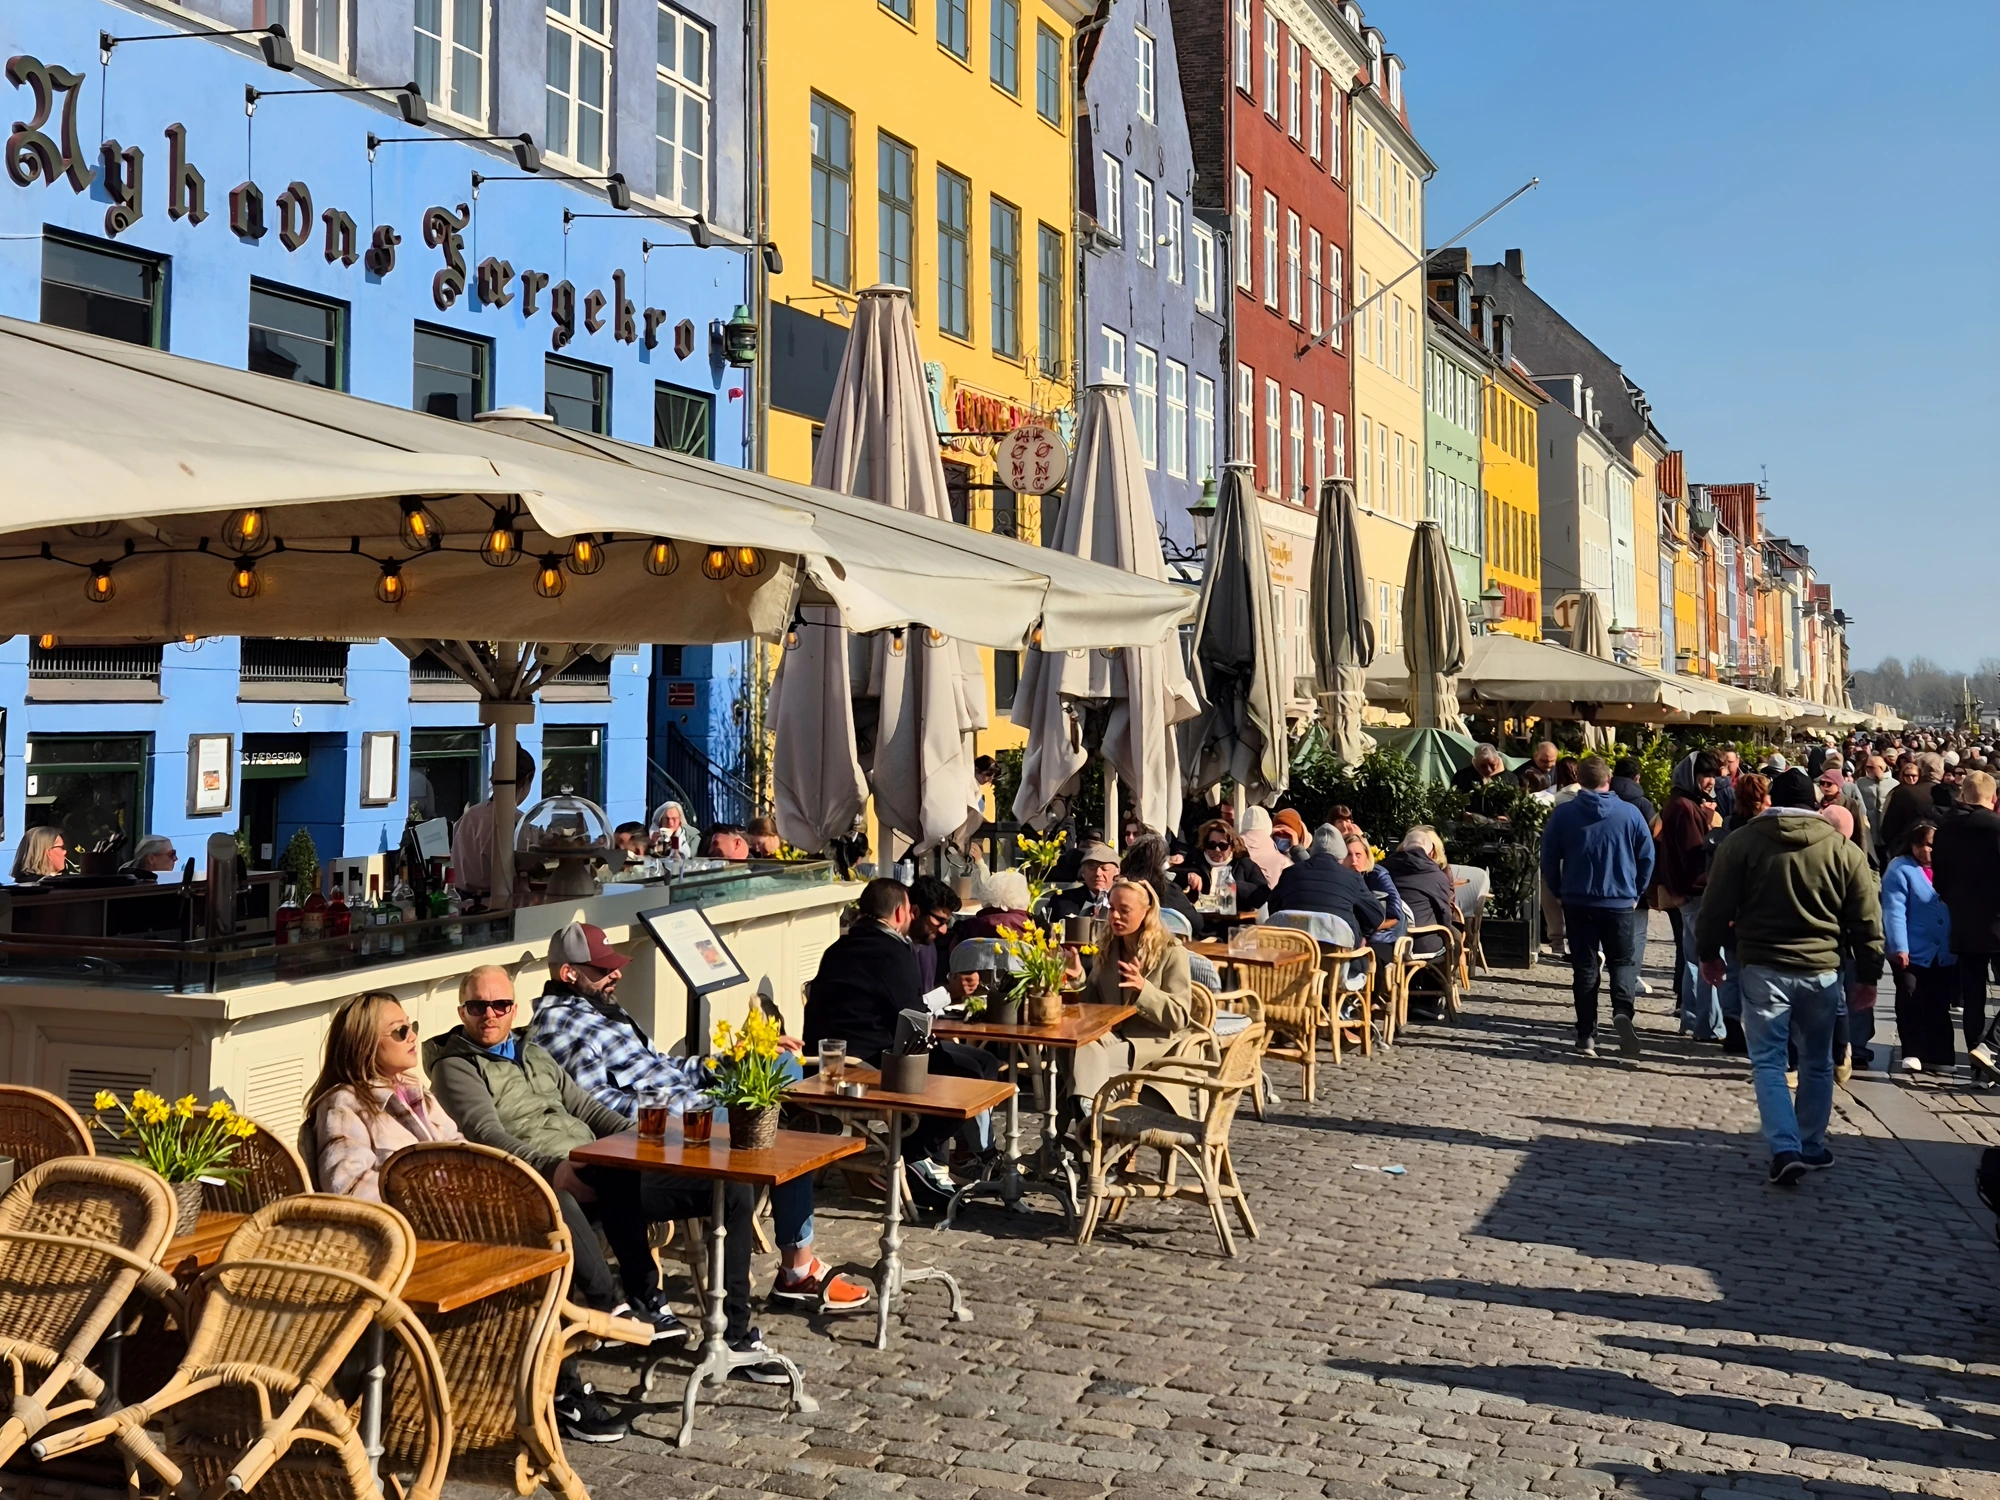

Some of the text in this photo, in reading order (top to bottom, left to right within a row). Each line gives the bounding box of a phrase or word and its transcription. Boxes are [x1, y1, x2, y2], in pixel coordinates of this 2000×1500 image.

[5, 55, 695, 360] Nyhavns Færgekro
[293, 707, 303, 727] 6
